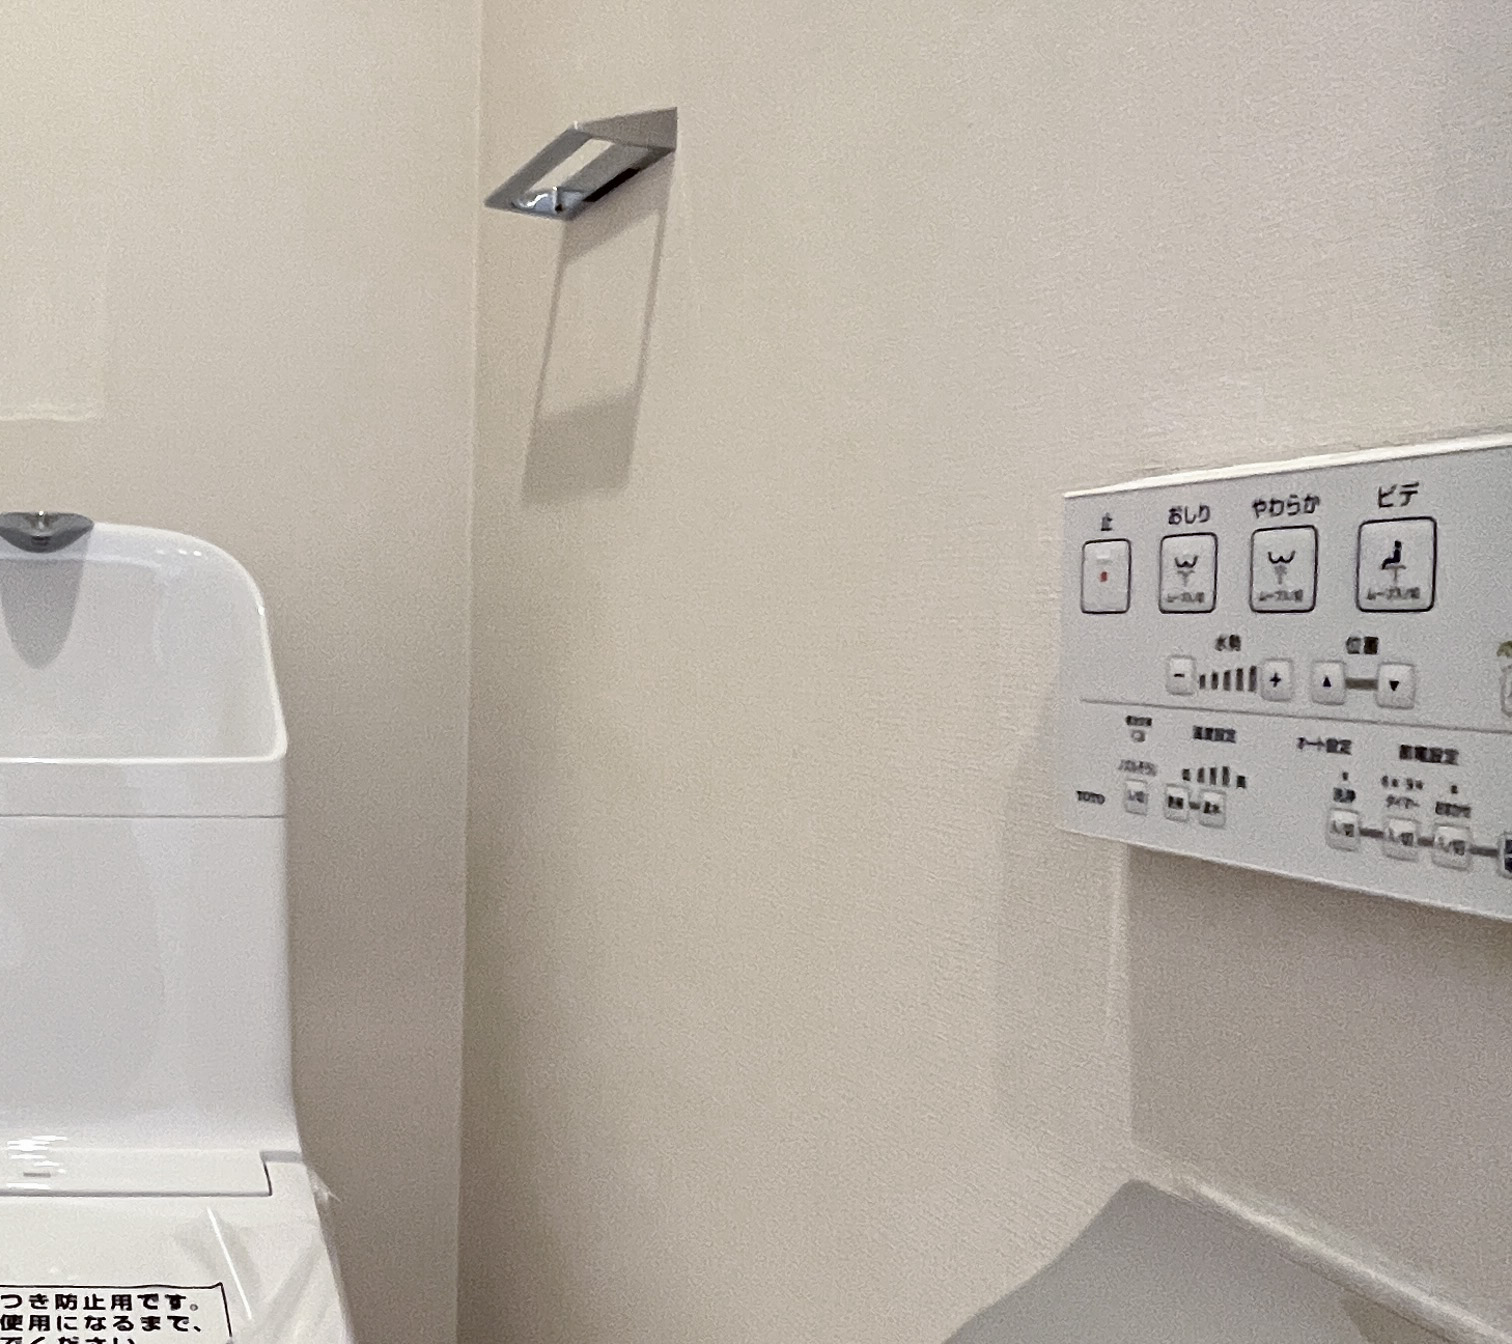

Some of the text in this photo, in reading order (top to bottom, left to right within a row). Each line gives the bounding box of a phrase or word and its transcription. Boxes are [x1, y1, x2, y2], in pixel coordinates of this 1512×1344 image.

[1168, 505, 1211, 526] おしり
[1252, 493, 1320, 518] やわらか
